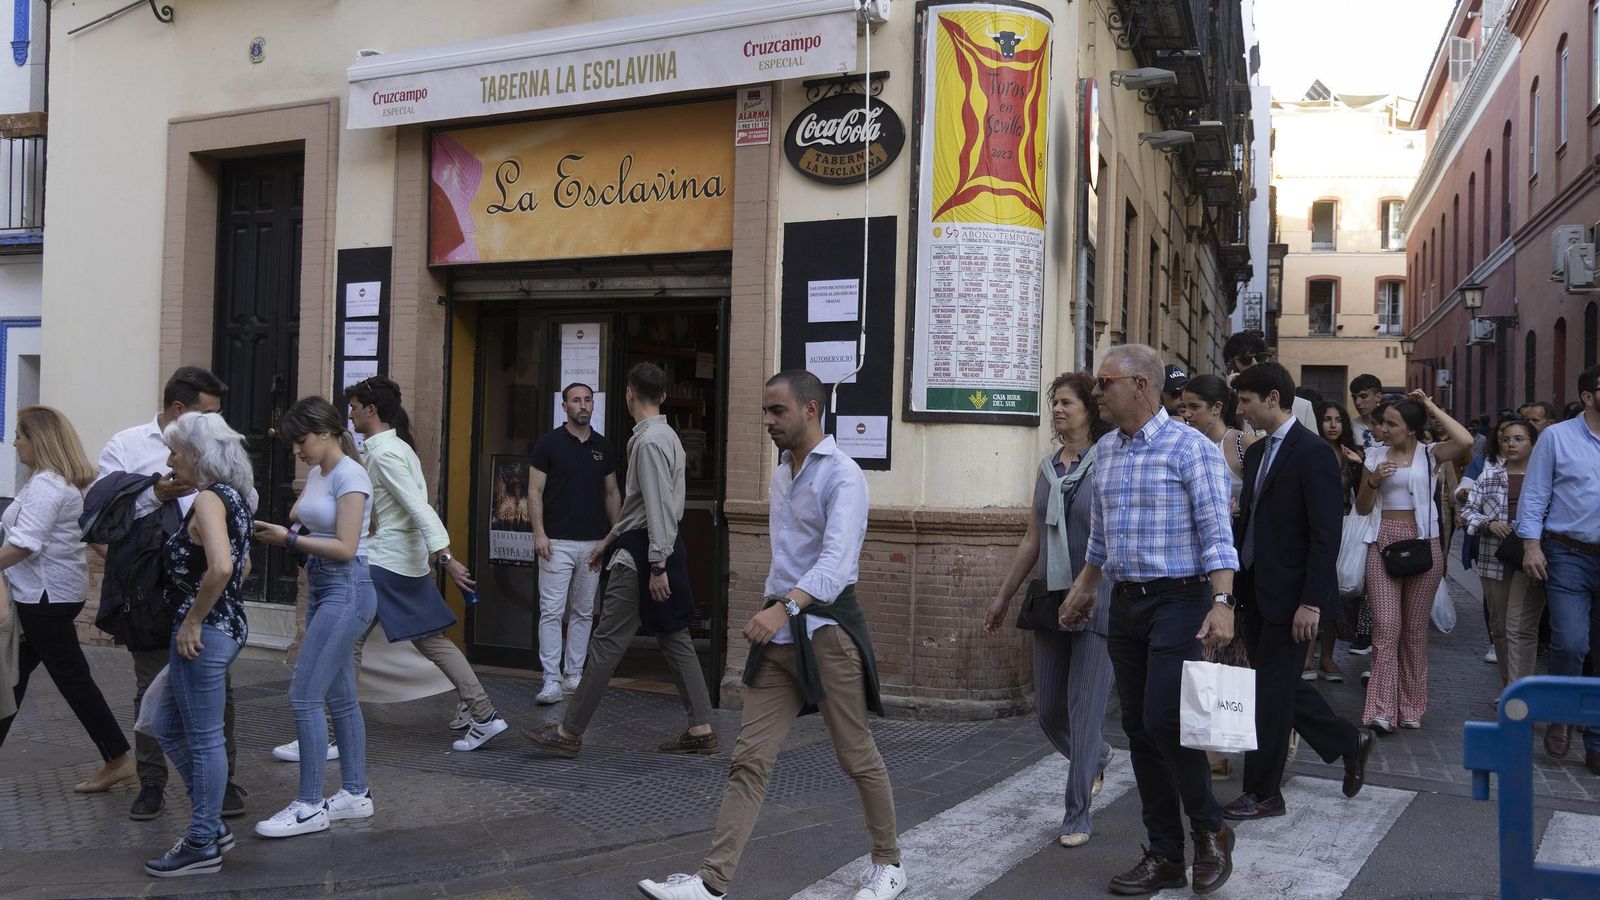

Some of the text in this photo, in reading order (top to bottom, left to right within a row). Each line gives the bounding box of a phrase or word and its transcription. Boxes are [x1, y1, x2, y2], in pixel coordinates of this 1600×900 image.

[743, 34, 822, 58] Cruzcampo
[758, 56, 806, 71] ESPECIAL
[480, 50, 678, 104] TABERNA LA ESCLAVINA
[986, 72, 1025, 99] Toros
[372, 87, 428, 106] Cruzcampo
[382, 105, 416, 118] ESPECIAL
[737, 110, 770, 121] ALARMA
[999, 102, 1014, 114] en
[795, 107, 884, 147] Coca-Cola
[987, 114, 1024, 138] Sevilla
[815, 149, 874, 165] TABERNA
[991, 148, 1014, 160] 2023
[806, 160, 818, 173] LA
[486, 153, 727, 215] La Esclavina
[961, 231, 996, 239] ABONO
[809, 355, 853, 363] AUTOSERVICIO
[493, 532, 518, 541] SEMANA
